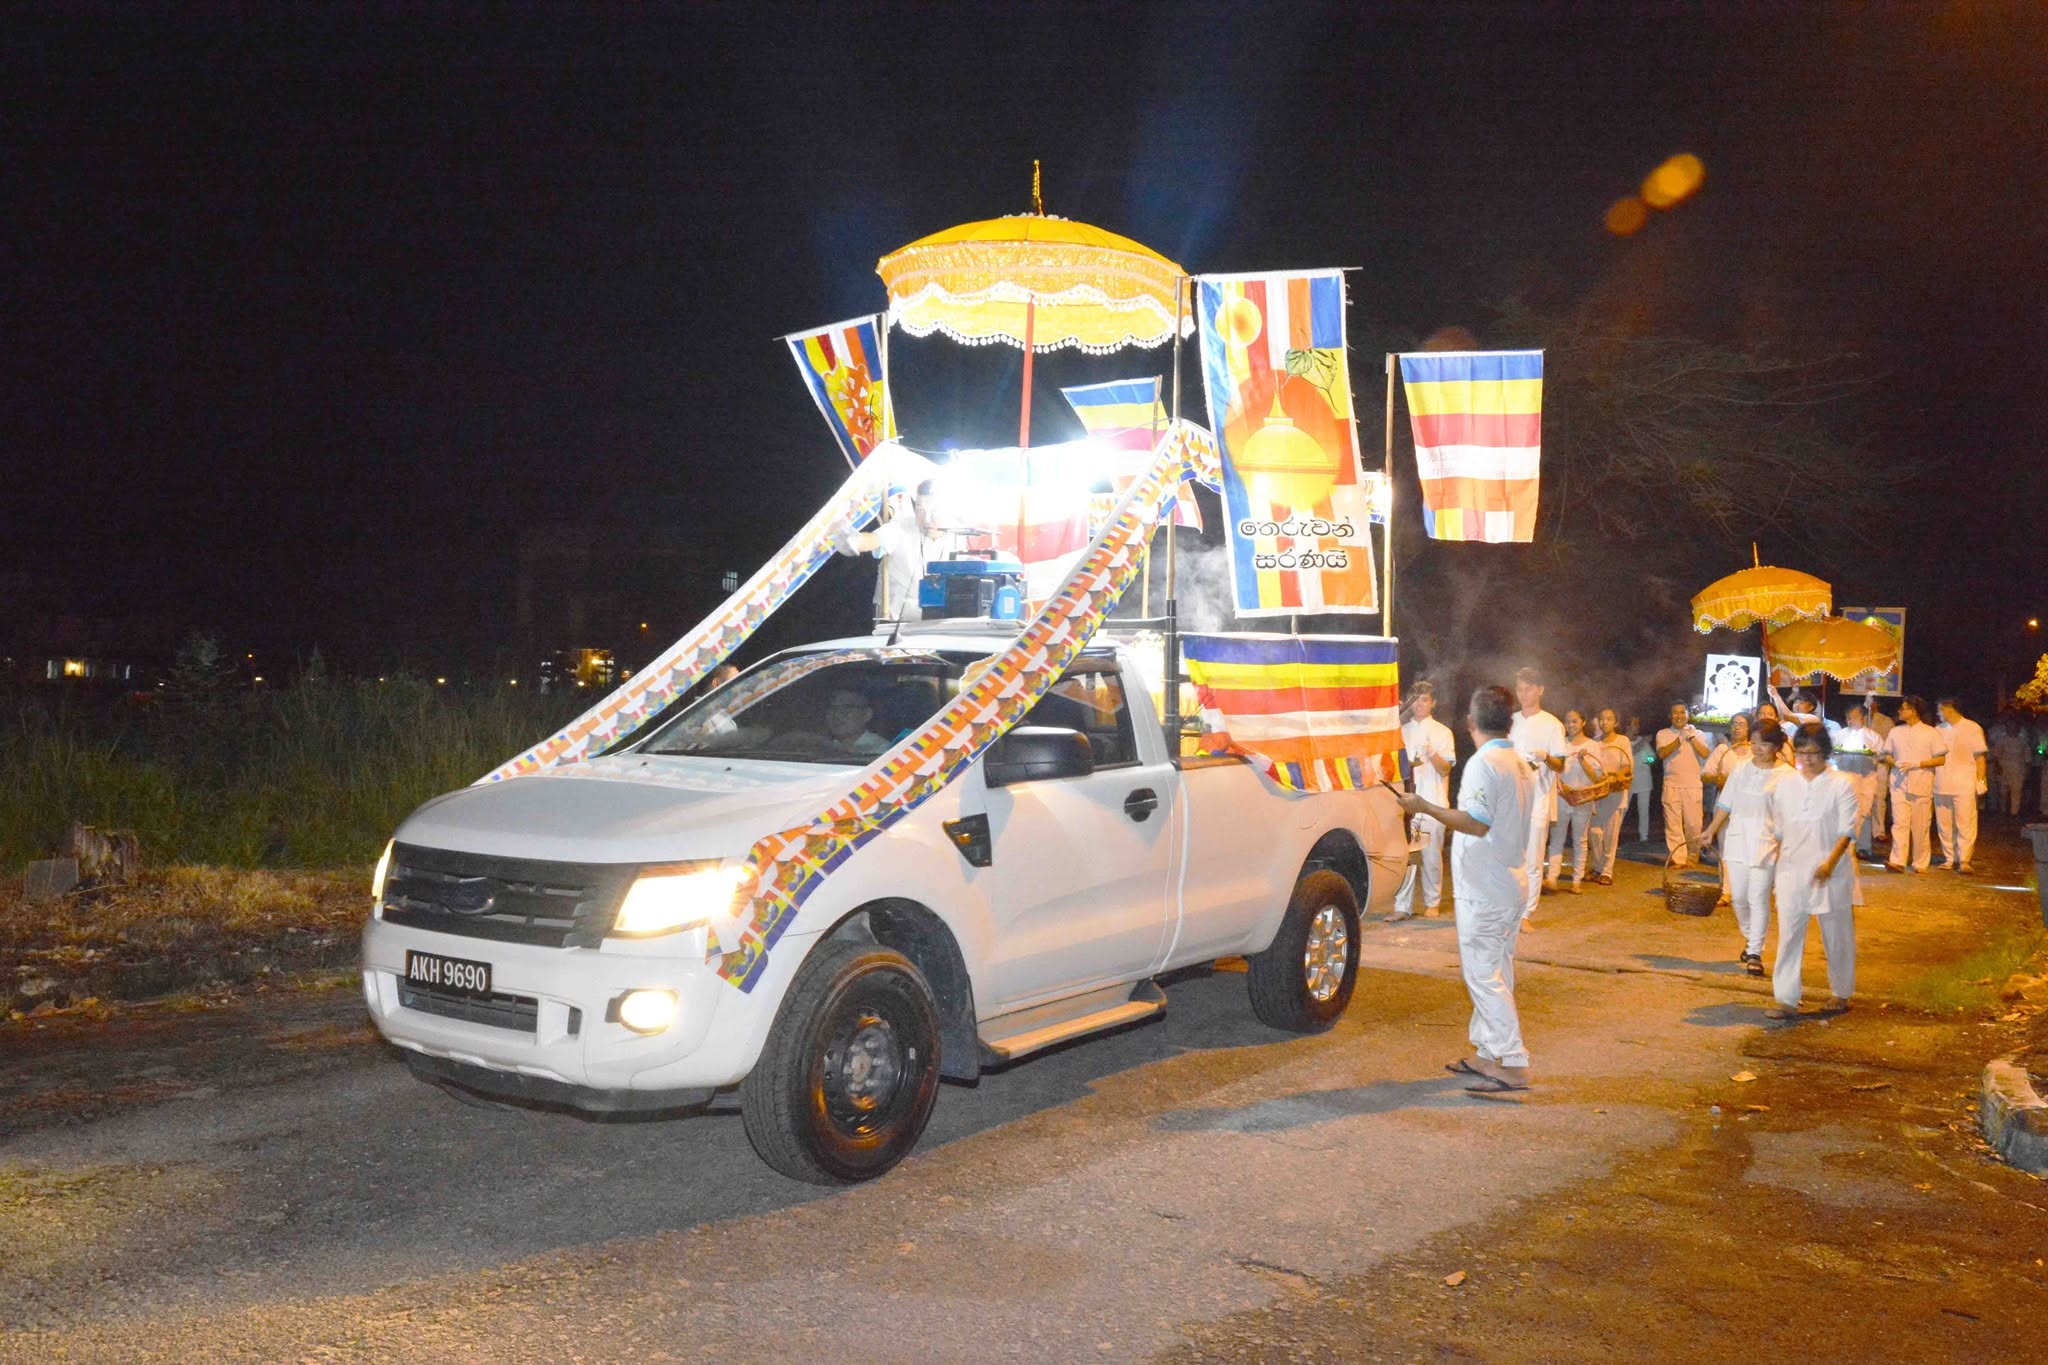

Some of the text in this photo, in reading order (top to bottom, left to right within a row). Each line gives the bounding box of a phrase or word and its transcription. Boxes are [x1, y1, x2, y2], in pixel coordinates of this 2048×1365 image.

[1240, 516, 1354, 537] තෙරුවන්
[1255, 548, 1348, 569] සරණයි
[410, 955, 486, 992] AKH 9690
